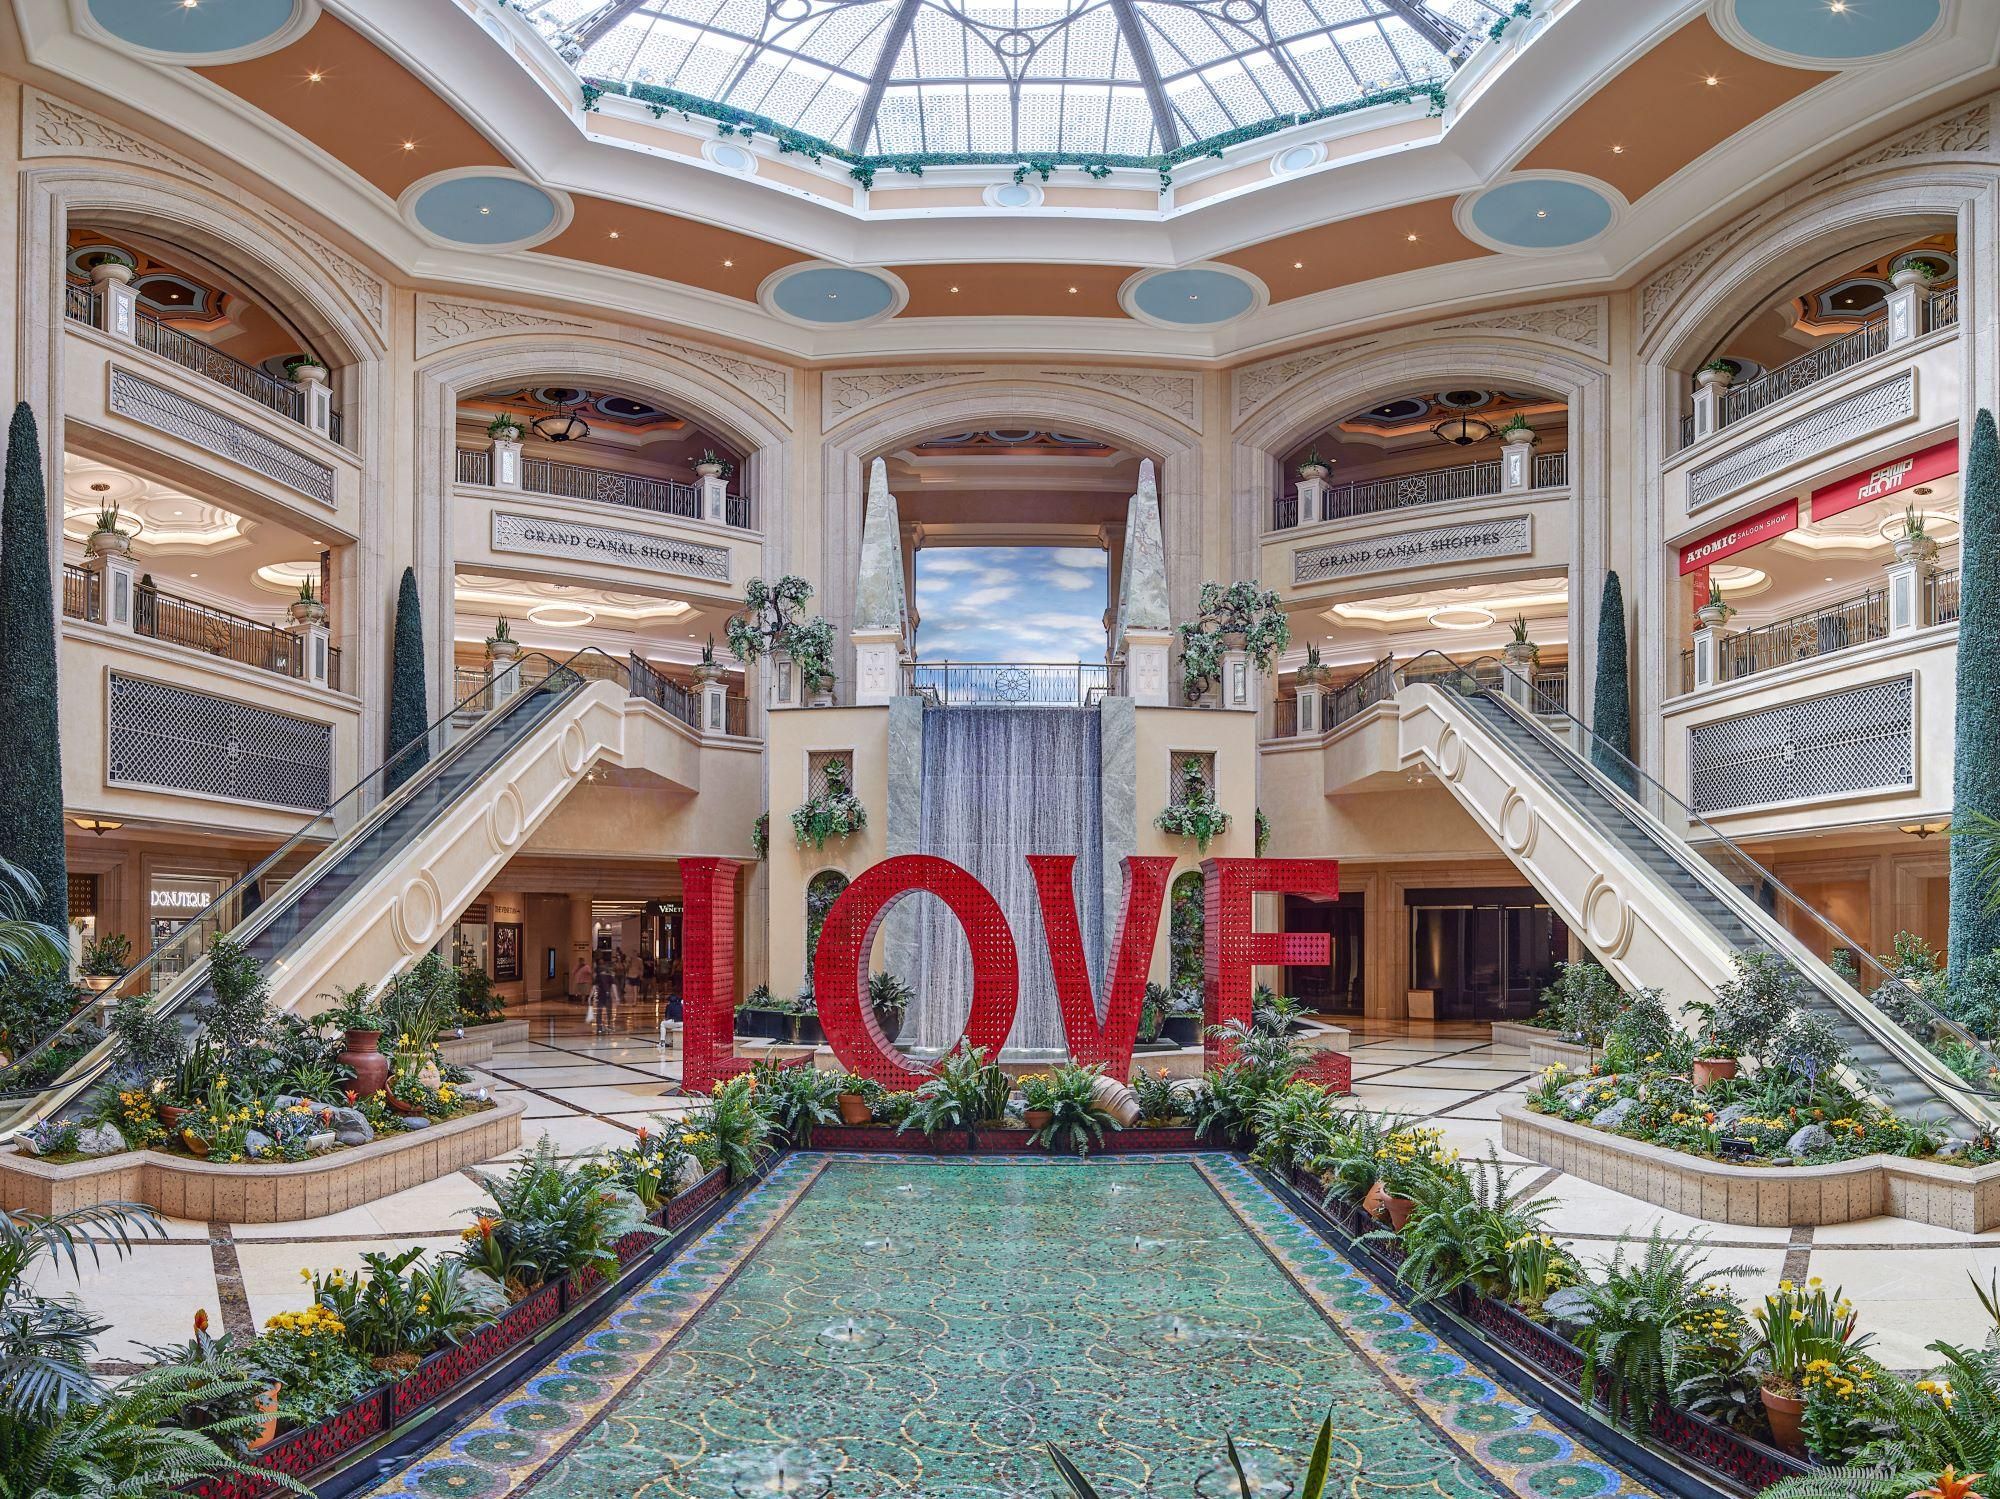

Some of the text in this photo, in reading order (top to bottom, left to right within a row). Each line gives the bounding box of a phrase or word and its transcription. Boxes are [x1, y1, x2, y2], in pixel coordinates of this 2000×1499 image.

[524, 529, 705, 566] GRAND CANAL SHOPPES
[1319, 532, 1500, 568] GRAND CANAL SHOPPES
[1686, 514, 1786, 564] ATOMIC SALOON SHOW
[150, 890, 210, 907] DONUTIQUE
[659, 904, 684, 913] VENETI
[680, 855, 1352, 1096] LOVE
